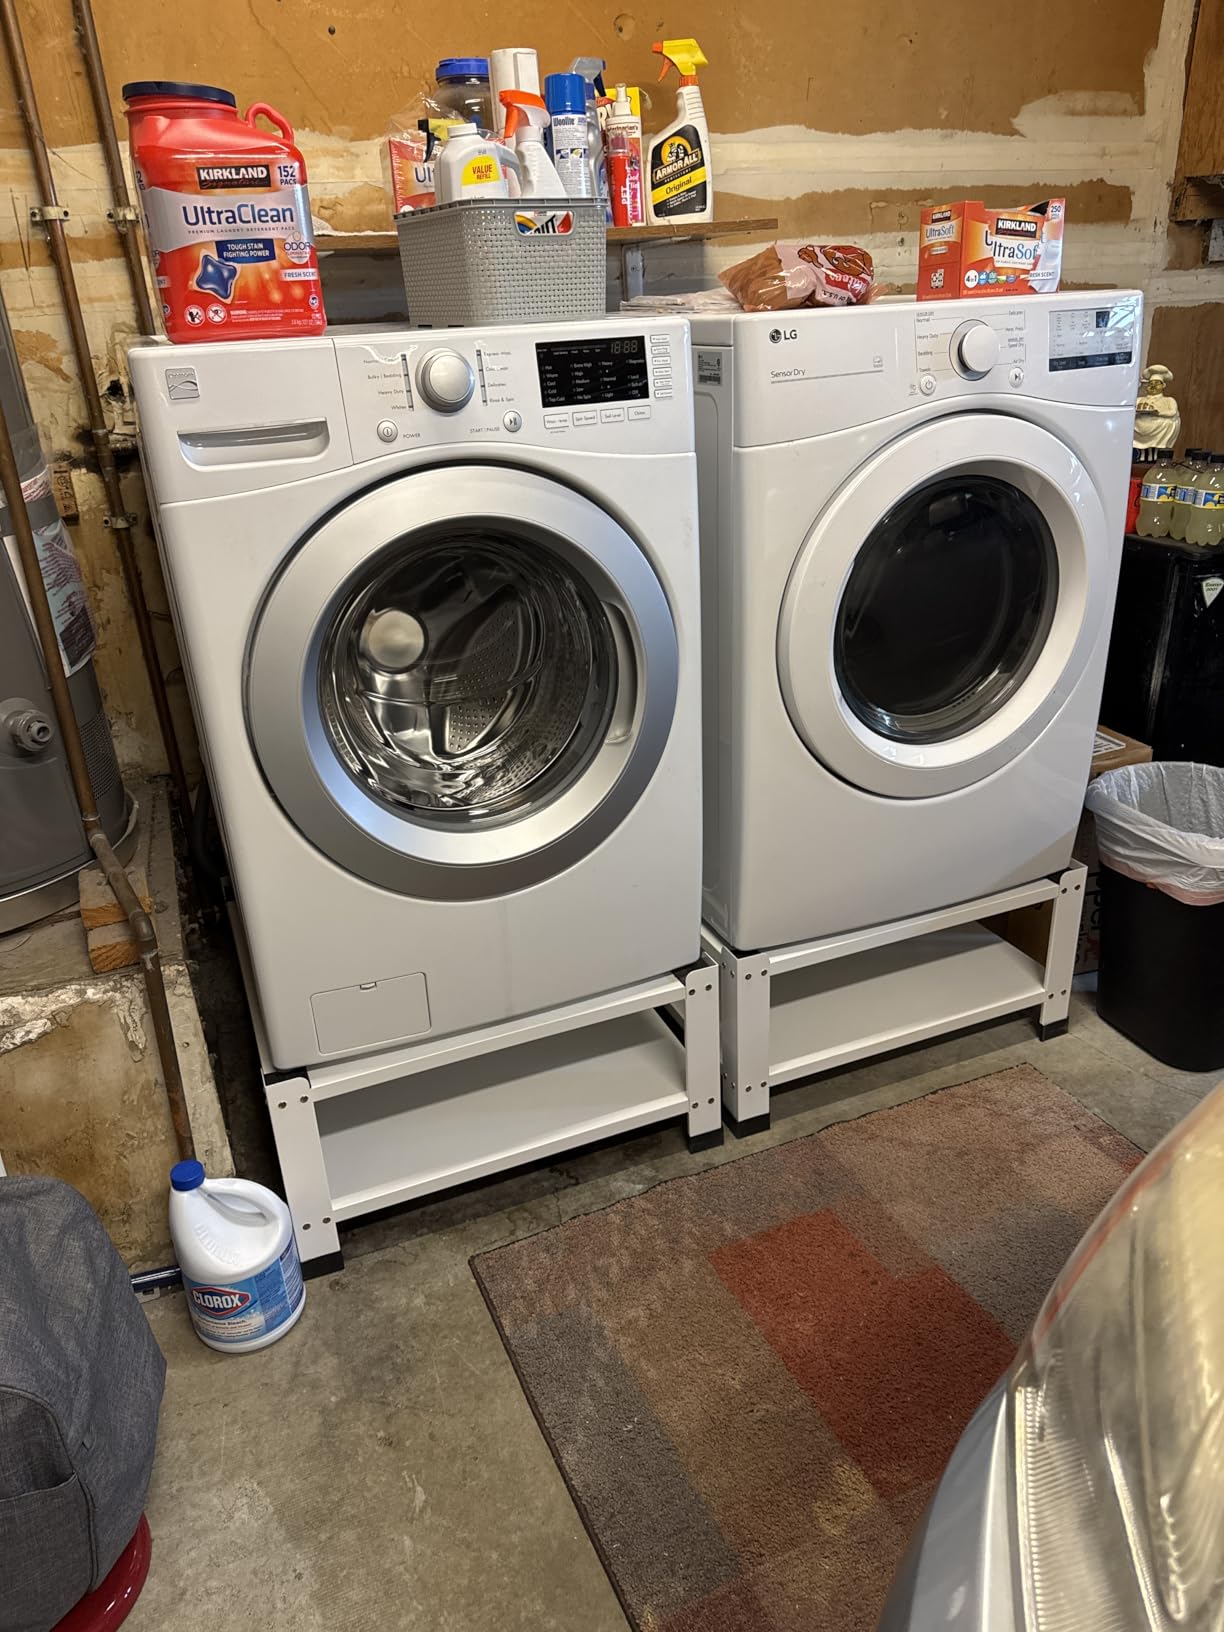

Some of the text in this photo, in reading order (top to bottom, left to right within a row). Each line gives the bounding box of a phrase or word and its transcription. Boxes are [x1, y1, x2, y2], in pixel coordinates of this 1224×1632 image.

[278, 165, 296, 178] 152
[472, 164, 492, 174] VALUE
[656, 152, 698, 180] ARMOR ALL
[200, 166, 268, 180] KIRKLAND
[280, 178, 297, 186] PACS
[665, 177, 692, 195] Original
[1051, 205, 1061, 213] 250
[182, 203, 294, 227] UltraClean
[932, 211, 951, 220] KIRKLAND
[998, 218, 1036, 232] KIRKLAND
[925, 224, 954, 239] UltraSoft
[227, 242, 263, 251] TOUGH STAIN
[284, 241, 311, 250] ODOR
[223, 250, 249, 258] FIGHTING
[784, 329, 798, 340] LG
[770, 368, 806, 379] Sensor Dry
[192, 1290, 242, 1309] CLOROX
